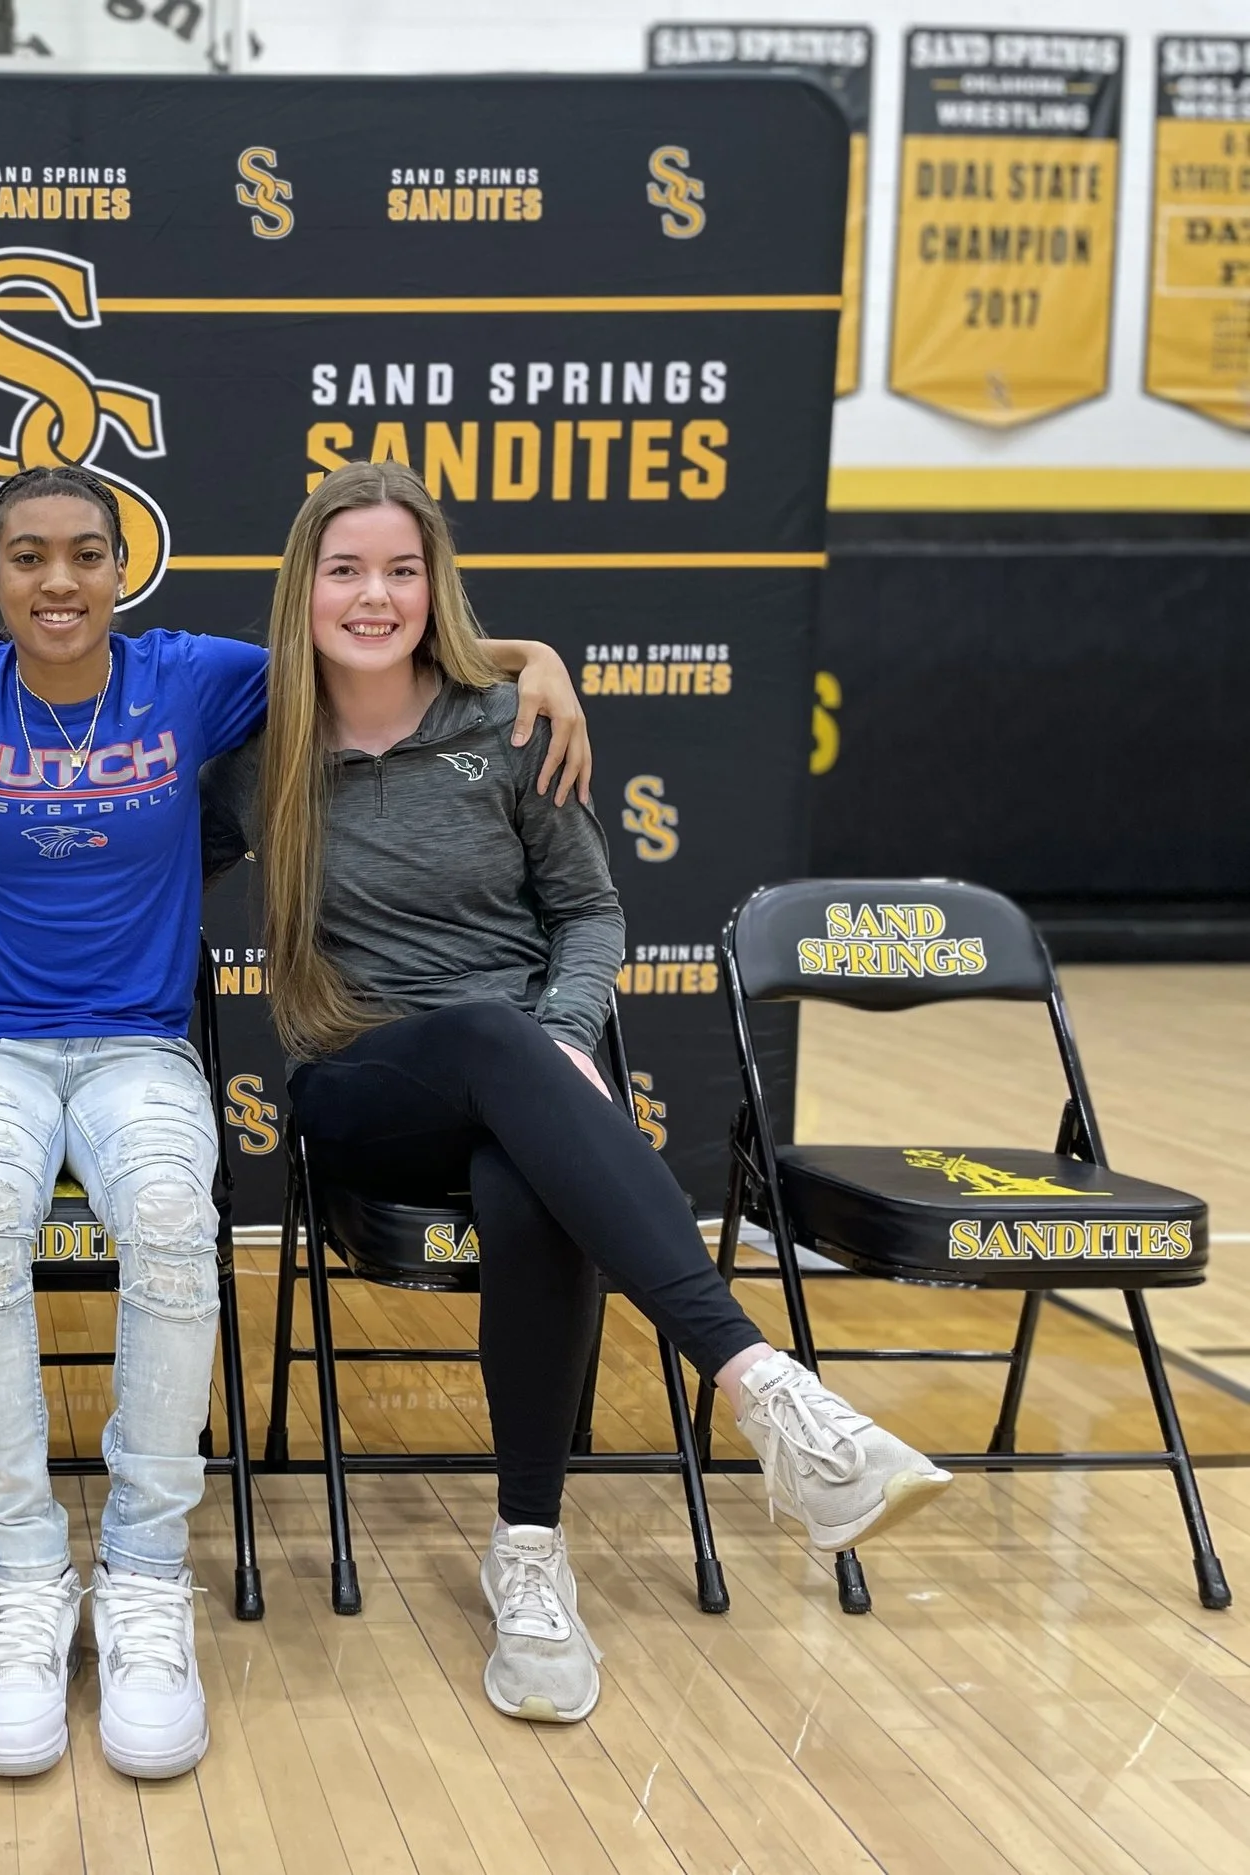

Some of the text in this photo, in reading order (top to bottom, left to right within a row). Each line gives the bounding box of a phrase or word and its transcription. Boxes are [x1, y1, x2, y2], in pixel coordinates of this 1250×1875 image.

[910, 33, 991, 68] SAND
[936, 101, 1090, 130] WRESTLING
[42, 166, 127, 185] SPRINGS
[391, 167, 539, 186] SAND SPRINGS
[915, 160, 1101, 202] DUAL STATE
[387, 188, 543, 222] SANDITES
[918, 224, 1092, 265] CHAMPION
[964, 289, 1041, 328] 2017
[312, 361, 728, 405] SAND SPRINGS
[306, 420, 730, 501] SANDITES
[585, 644, 730, 662] SAND SPRINGS
[582, 662, 732, 696] SANDITES
[826, 903, 945, 939] SAND
[636, 944, 715, 961] SPRINGS
[798, 938, 988, 978] SPRINGS
[616, 963, 719, 994] NDITES
[949, 1219, 1192, 1260] SANDITES
[758, 1375, 783, 1394] adidas
[514, 1544, 539, 1552] adidas
